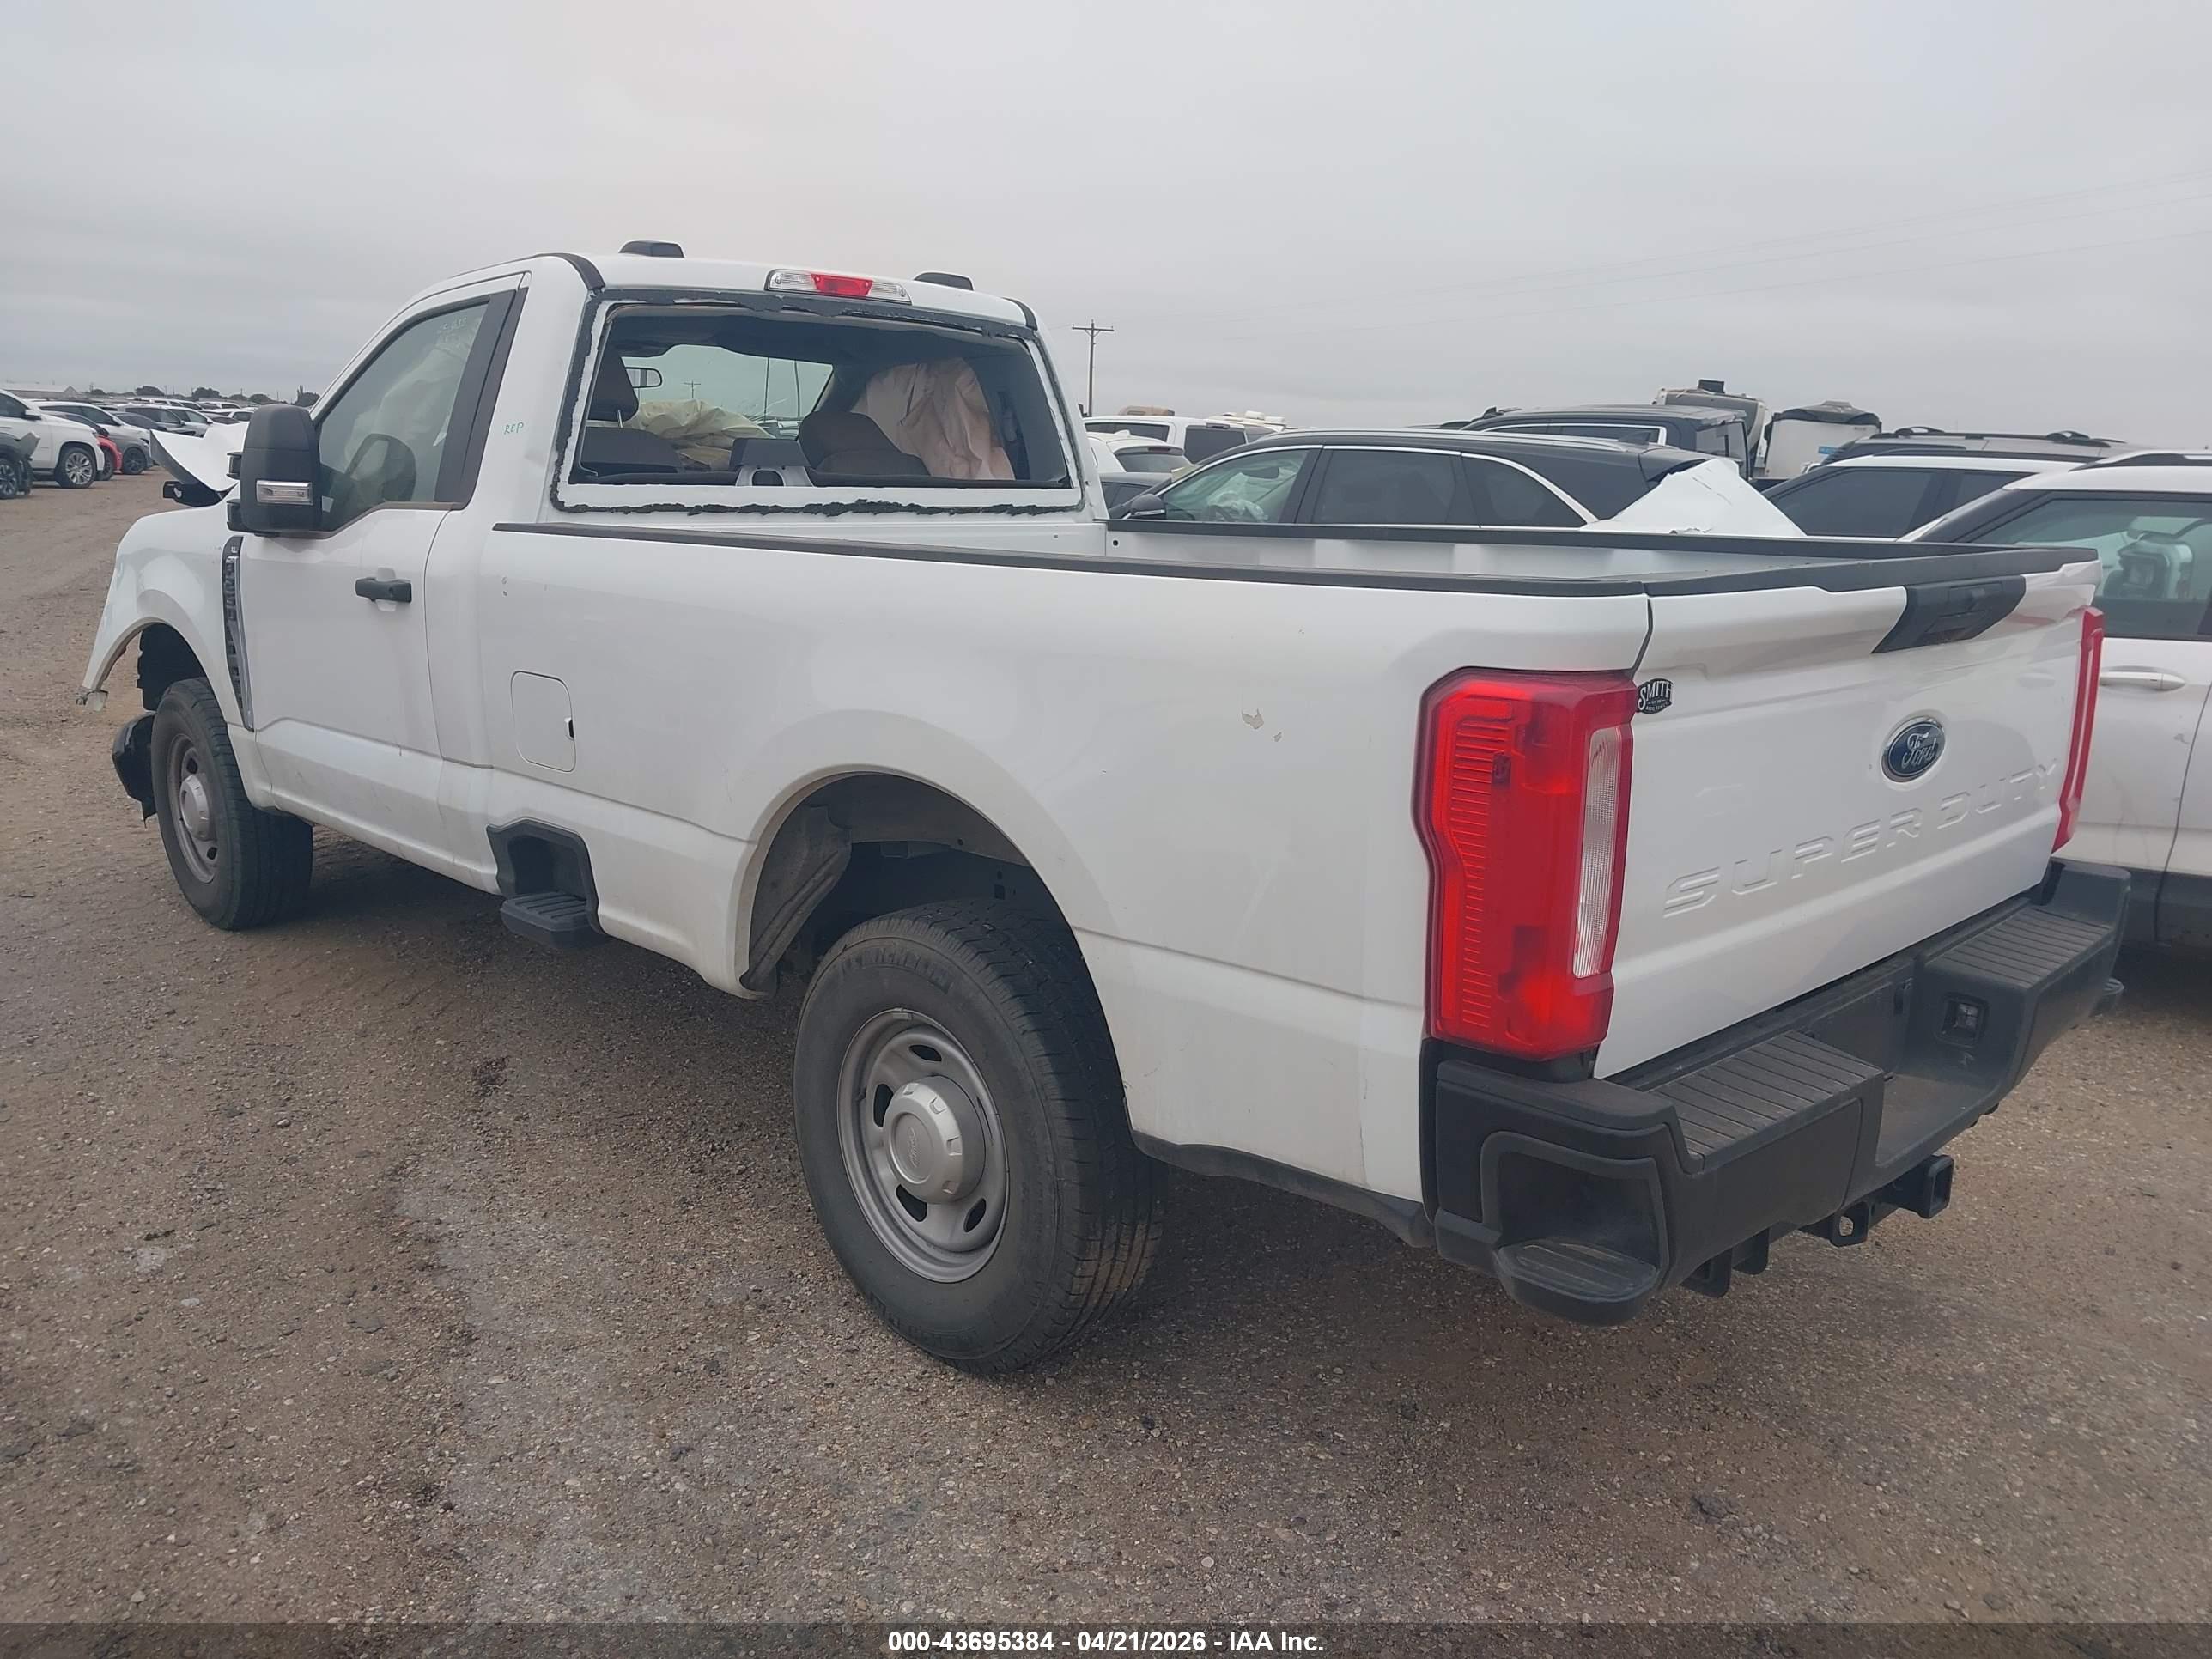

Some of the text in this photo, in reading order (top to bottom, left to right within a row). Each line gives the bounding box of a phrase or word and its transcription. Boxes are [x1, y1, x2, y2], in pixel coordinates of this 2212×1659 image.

[1638, 680, 1673, 710] SMITH
[1901, 732, 1937, 769] Ford
[1664, 763, 2058, 919] SUPER DUTY
